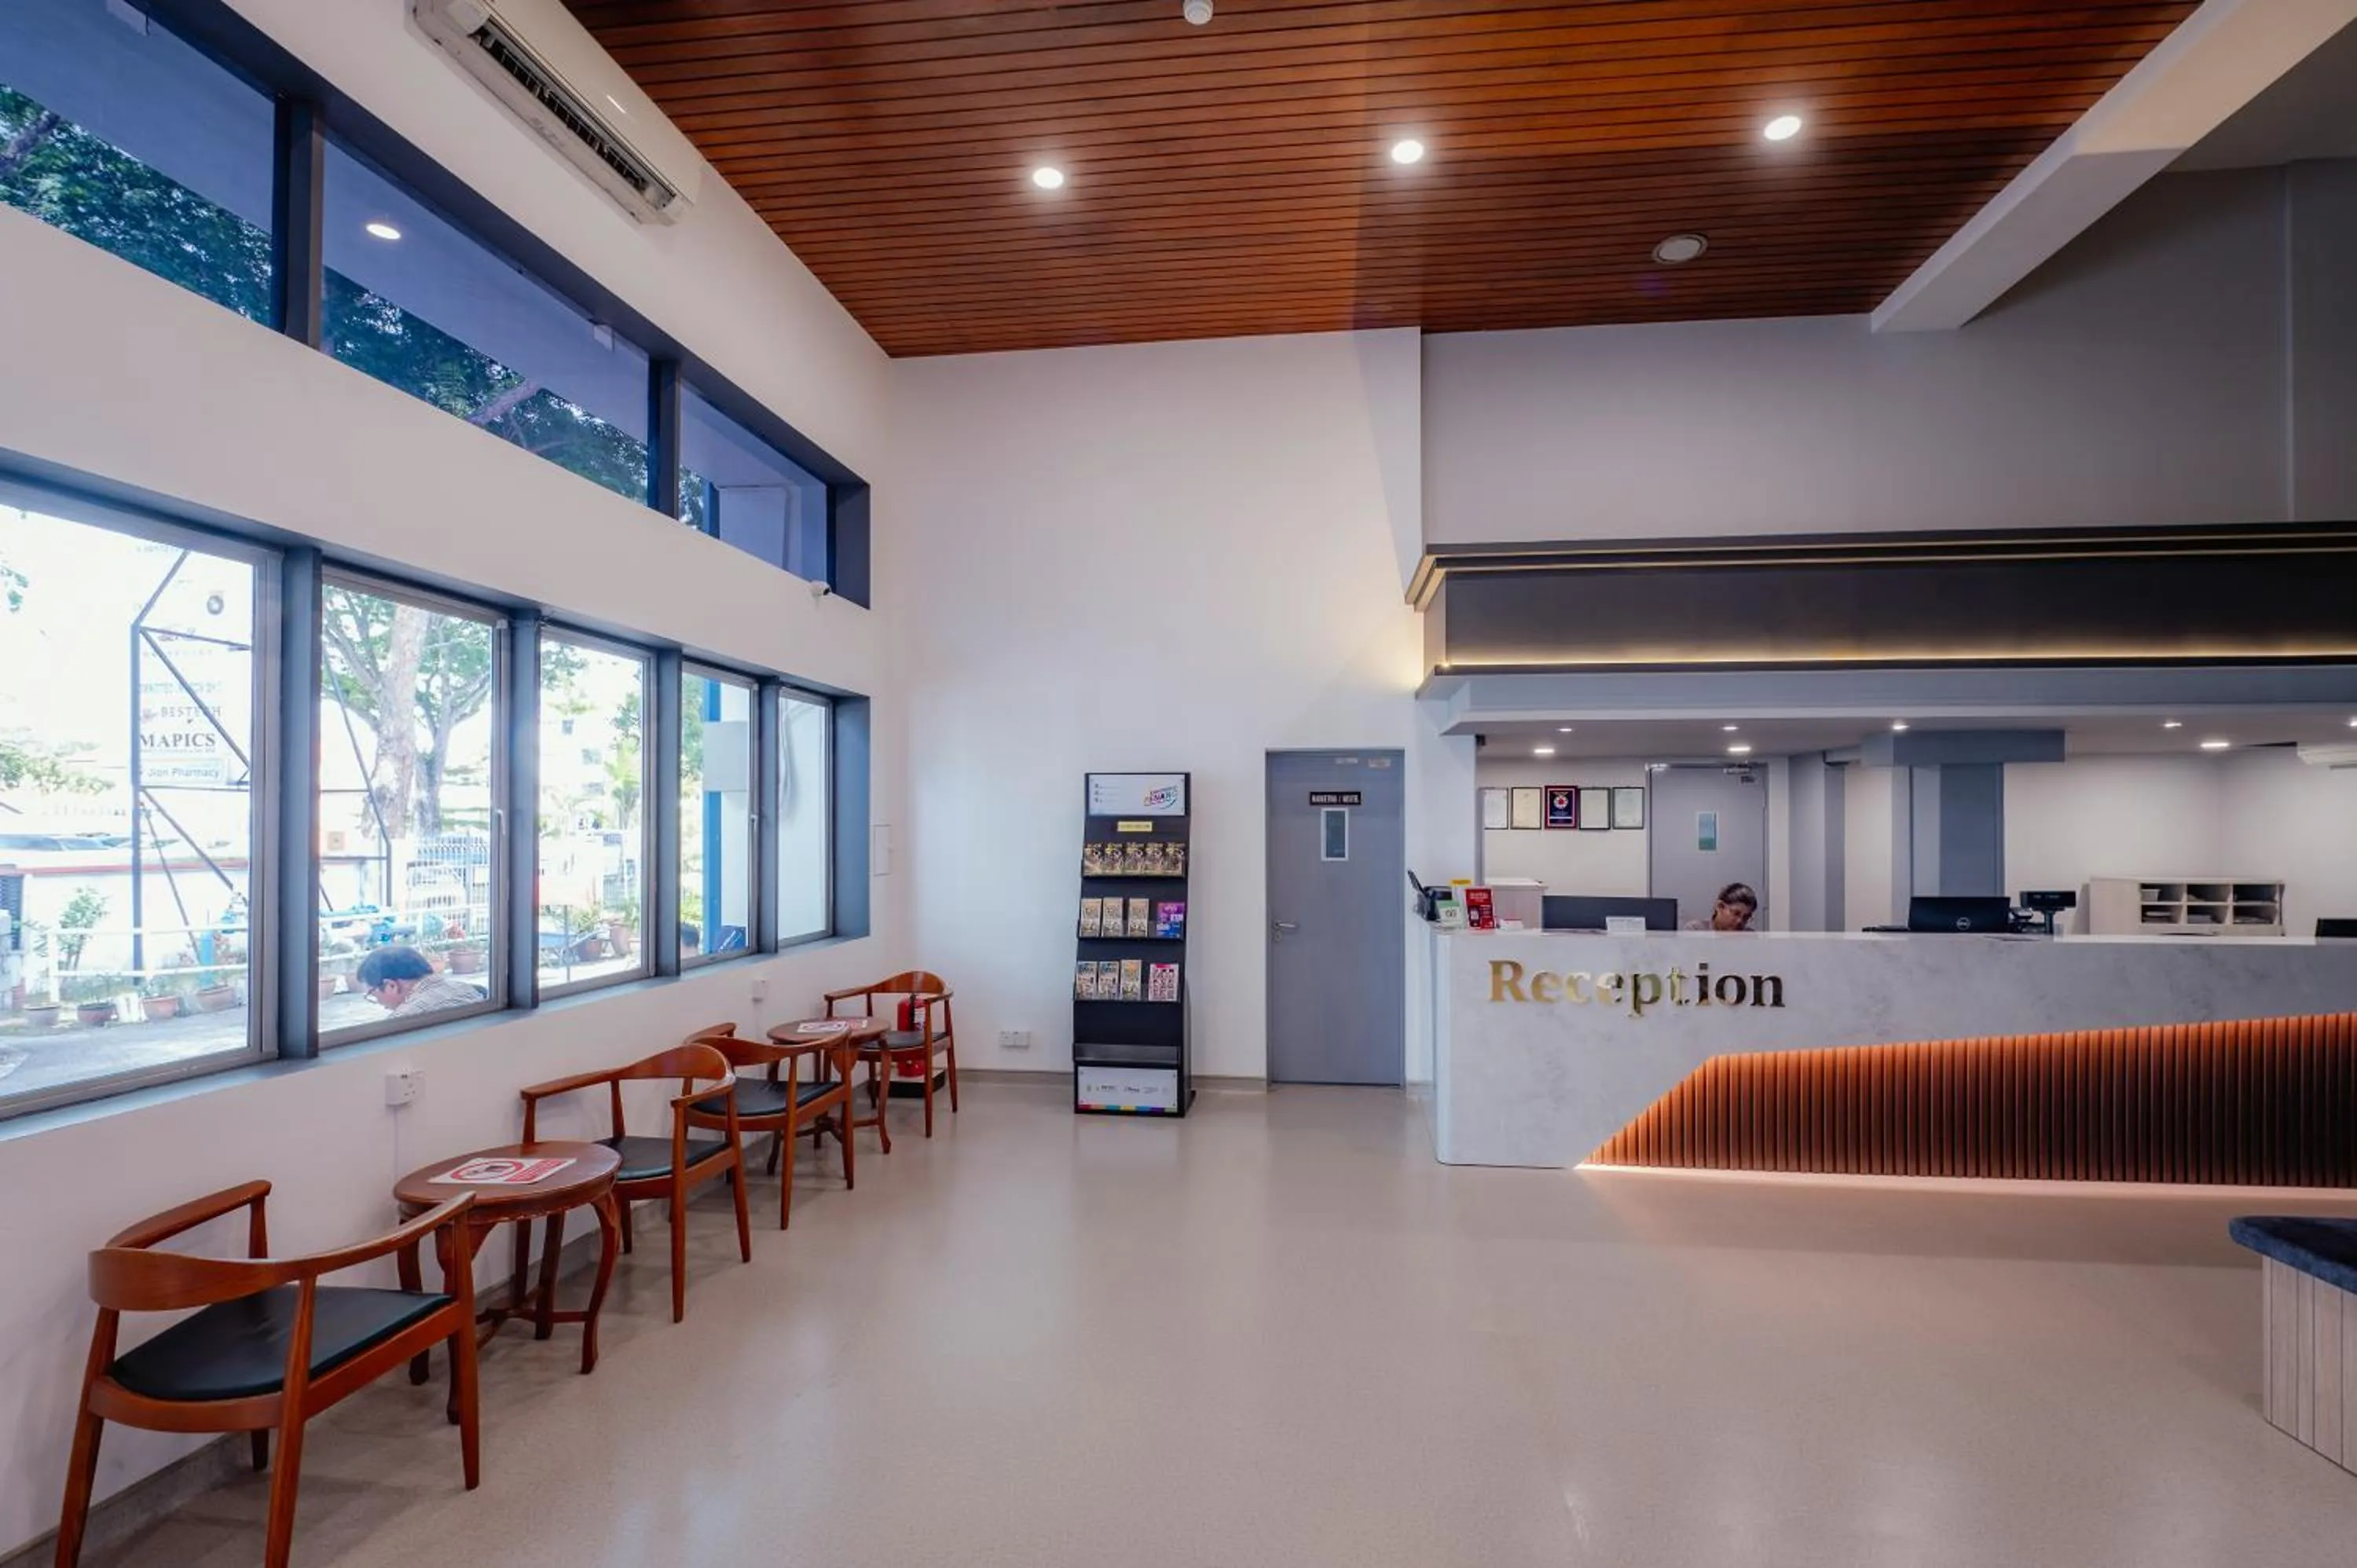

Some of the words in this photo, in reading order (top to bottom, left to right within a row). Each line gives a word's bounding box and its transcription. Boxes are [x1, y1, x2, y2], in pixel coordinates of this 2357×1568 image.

[161, 706, 221, 718] BESTEH
[140, 732, 216, 748] MAPICS
[1489, 959, 1785, 1017] Reception
